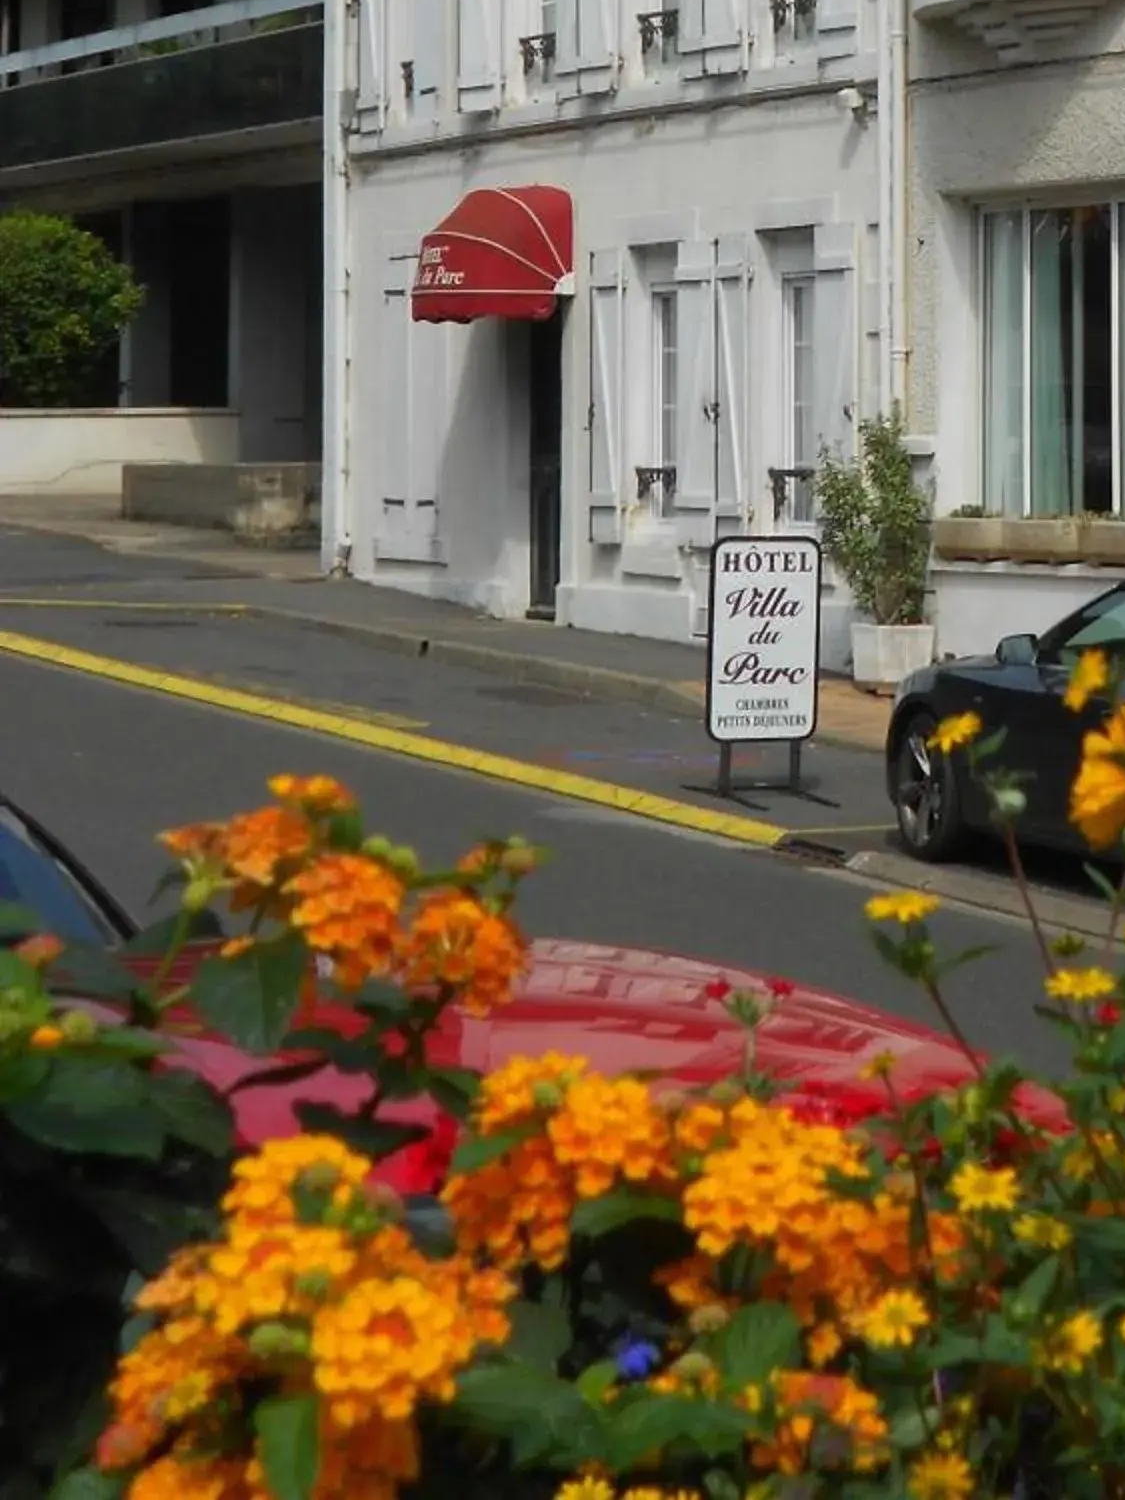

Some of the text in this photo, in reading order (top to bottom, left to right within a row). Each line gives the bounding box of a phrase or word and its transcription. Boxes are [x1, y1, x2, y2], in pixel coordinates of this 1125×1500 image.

[434, 265, 465, 285] Parc
[721, 545, 813, 573] HÔTEL
[725, 586, 805, 619] Villa
[747, 620, 783, 645] du
[718, 651, 811, 685] Parc
[717, 713, 751, 728] PETITS
